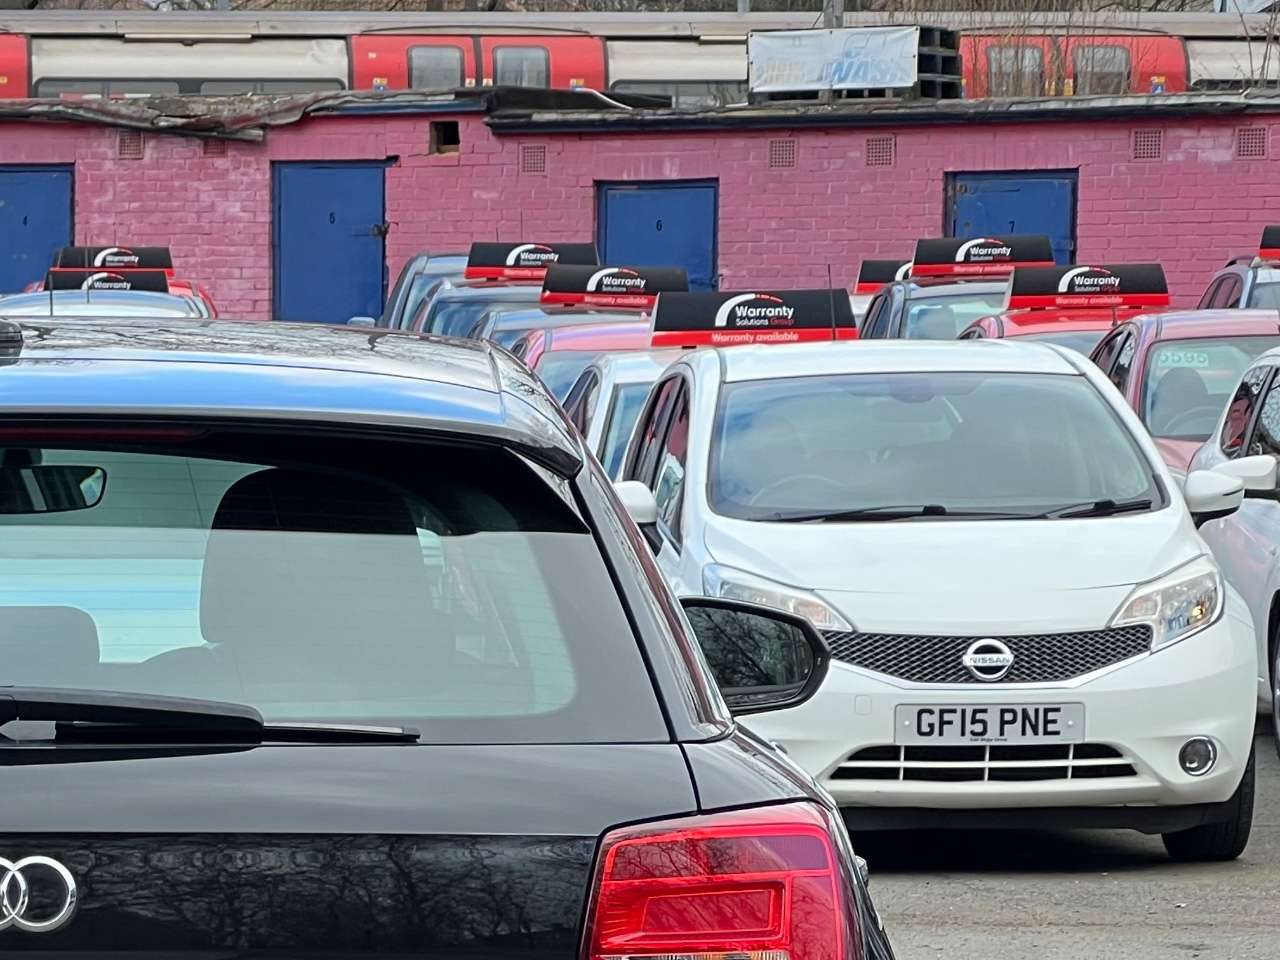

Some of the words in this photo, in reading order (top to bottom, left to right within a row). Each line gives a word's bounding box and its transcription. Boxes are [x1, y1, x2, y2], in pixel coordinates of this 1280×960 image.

[970, 246, 1011, 256] Warranty
[520, 252, 559, 262] Warranty
[94, 281, 131, 290] Warranty
[603, 276, 646, 287] Warranty
[1074, 276, 1120, 286] Warranty
[736, 305, 794, 318] Warranty
[736, 318, 768, 326] Solutions
[712, 332, 754, 343] Warranty
[756, 332, 799, 341] available
[970, 656, 1010, 665] NISSAN
[916, 707, 989, 738] GF15
[999, 706, 1062, 737] PNE
